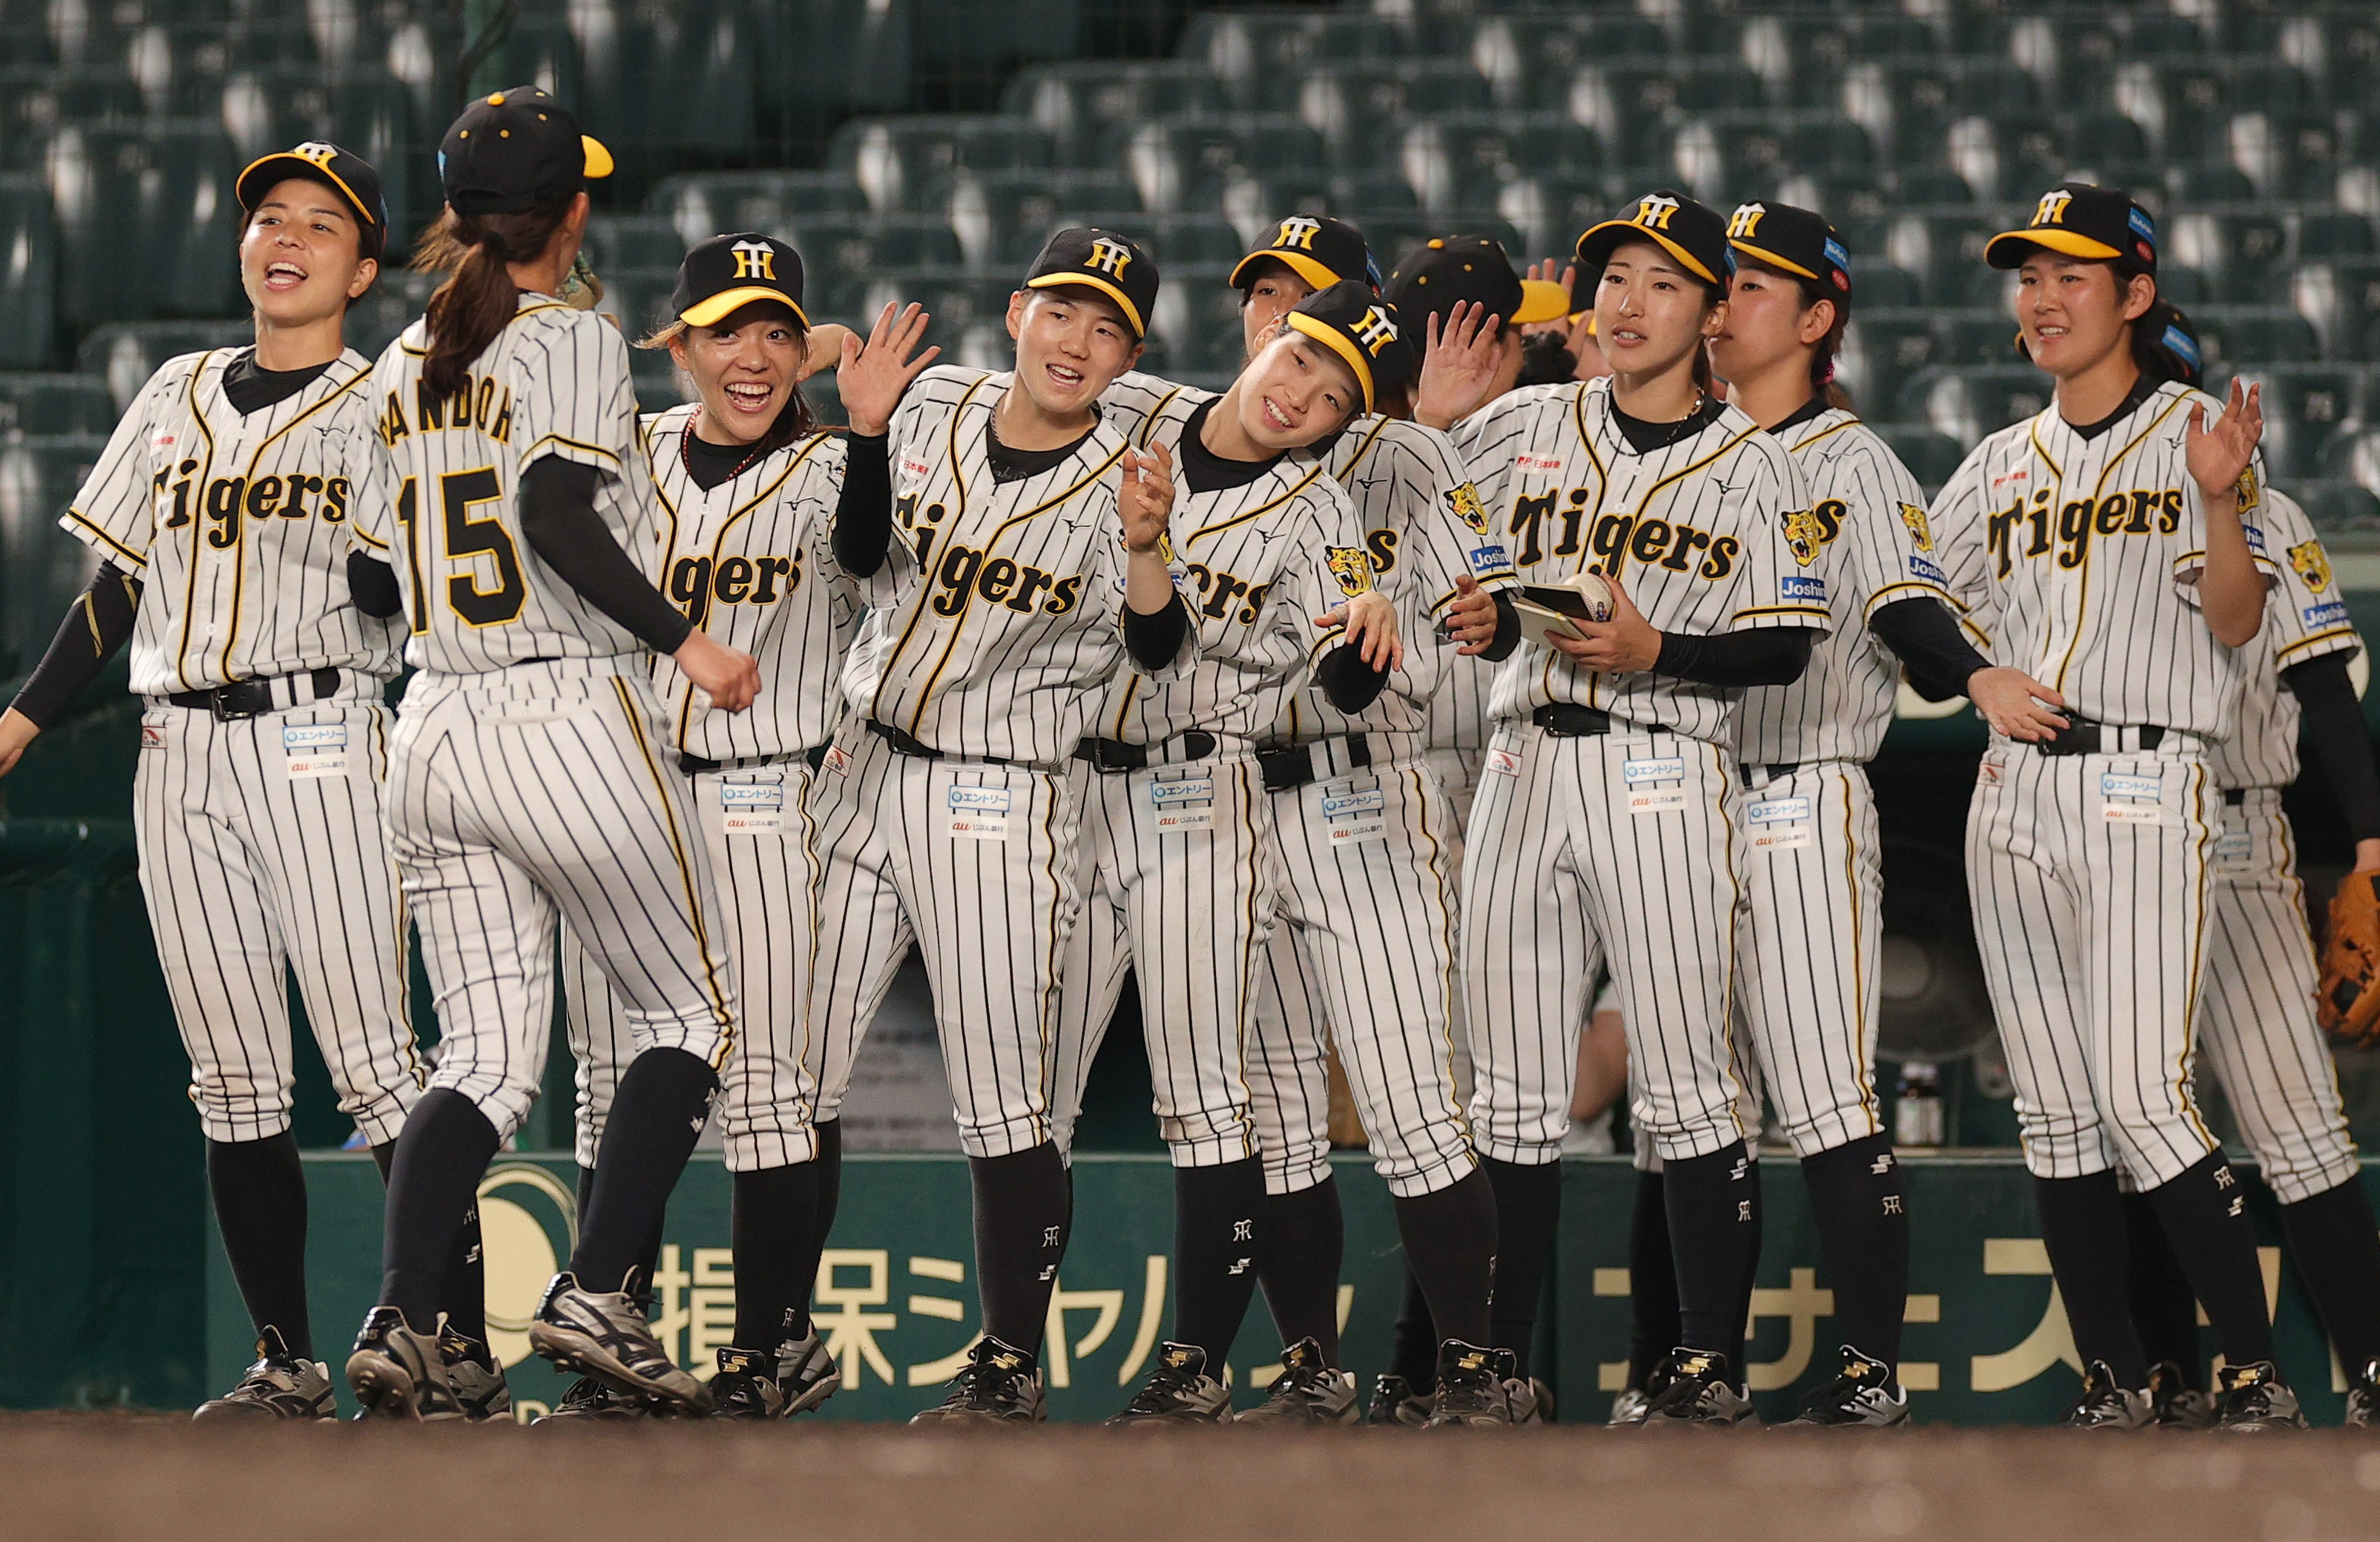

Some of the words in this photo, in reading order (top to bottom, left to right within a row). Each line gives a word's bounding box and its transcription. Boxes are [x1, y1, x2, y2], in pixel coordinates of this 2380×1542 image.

[1509, 487, 1739, 580] Tigers
[1988, 488, 2183, 582] Tigers
[397, 464, 527, 636] 15
[1475, 549, 1510, 568] Joshin
[298, 730, 346, 741] エントリー
[292, 762, 312, 772] au
[1638, 764, 1683, 775] エントリー
[737, 790, 781, 799] エントリー
[1166, 784, 1212, 795] エントリー
[963, 793, 1008, 803] エントリー
[1337, 796, 1381, 809] エントリー
[1632, 797, 1651, 806] au
[1763, 803, 1808, 816] エントリー
[728, 819, 747, 827] au
[952, 822, 971, 831] au
[1159, 817, 1179, 826] au
[1333, 829, 1352, 839] au
[1756, 836, 1774, 845] au
